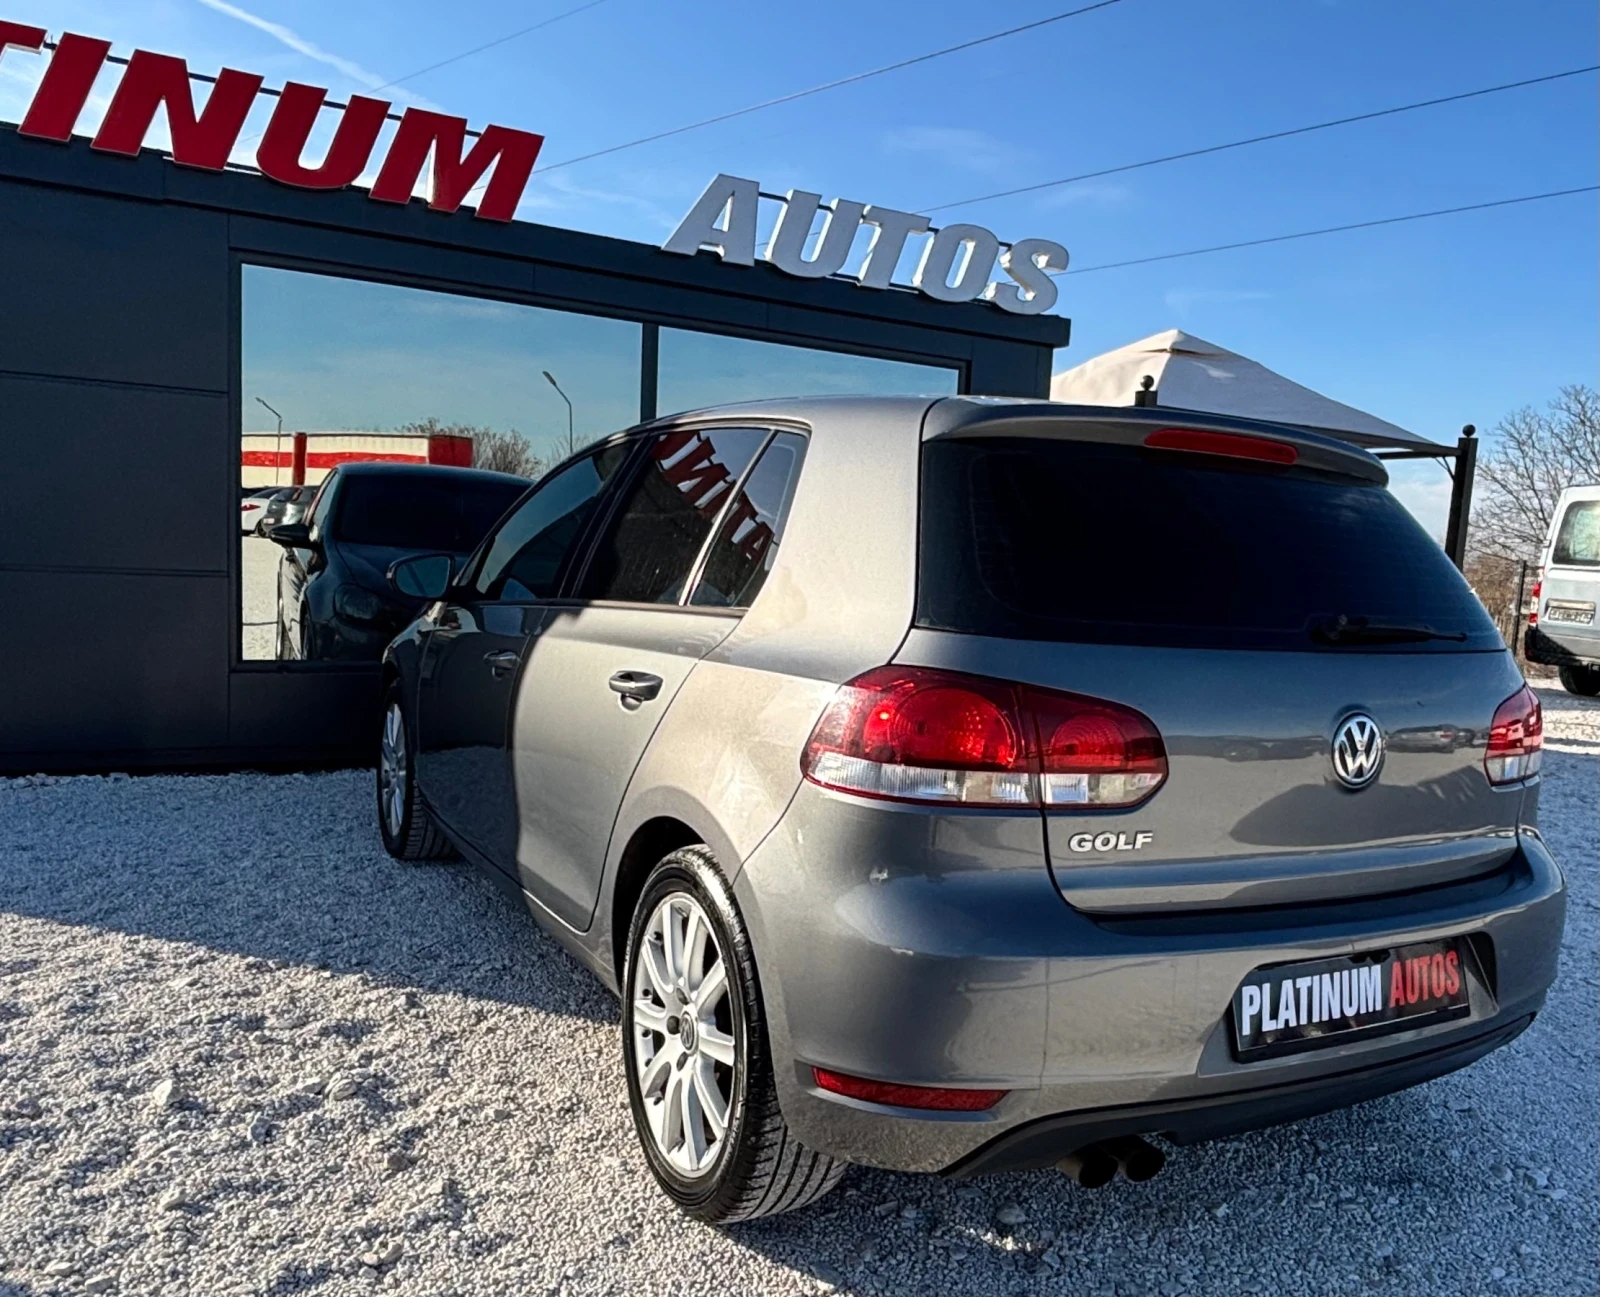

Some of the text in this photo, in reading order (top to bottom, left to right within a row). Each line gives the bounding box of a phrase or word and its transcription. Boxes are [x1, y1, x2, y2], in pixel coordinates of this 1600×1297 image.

[661, 173, 1070, 315] AUTOS
[1334, 714, 1381, 783] VW
[1069, 831, 1153, 852] GOLF
[1241, 950, 1460, 1036] PLATINUM AUTOS
